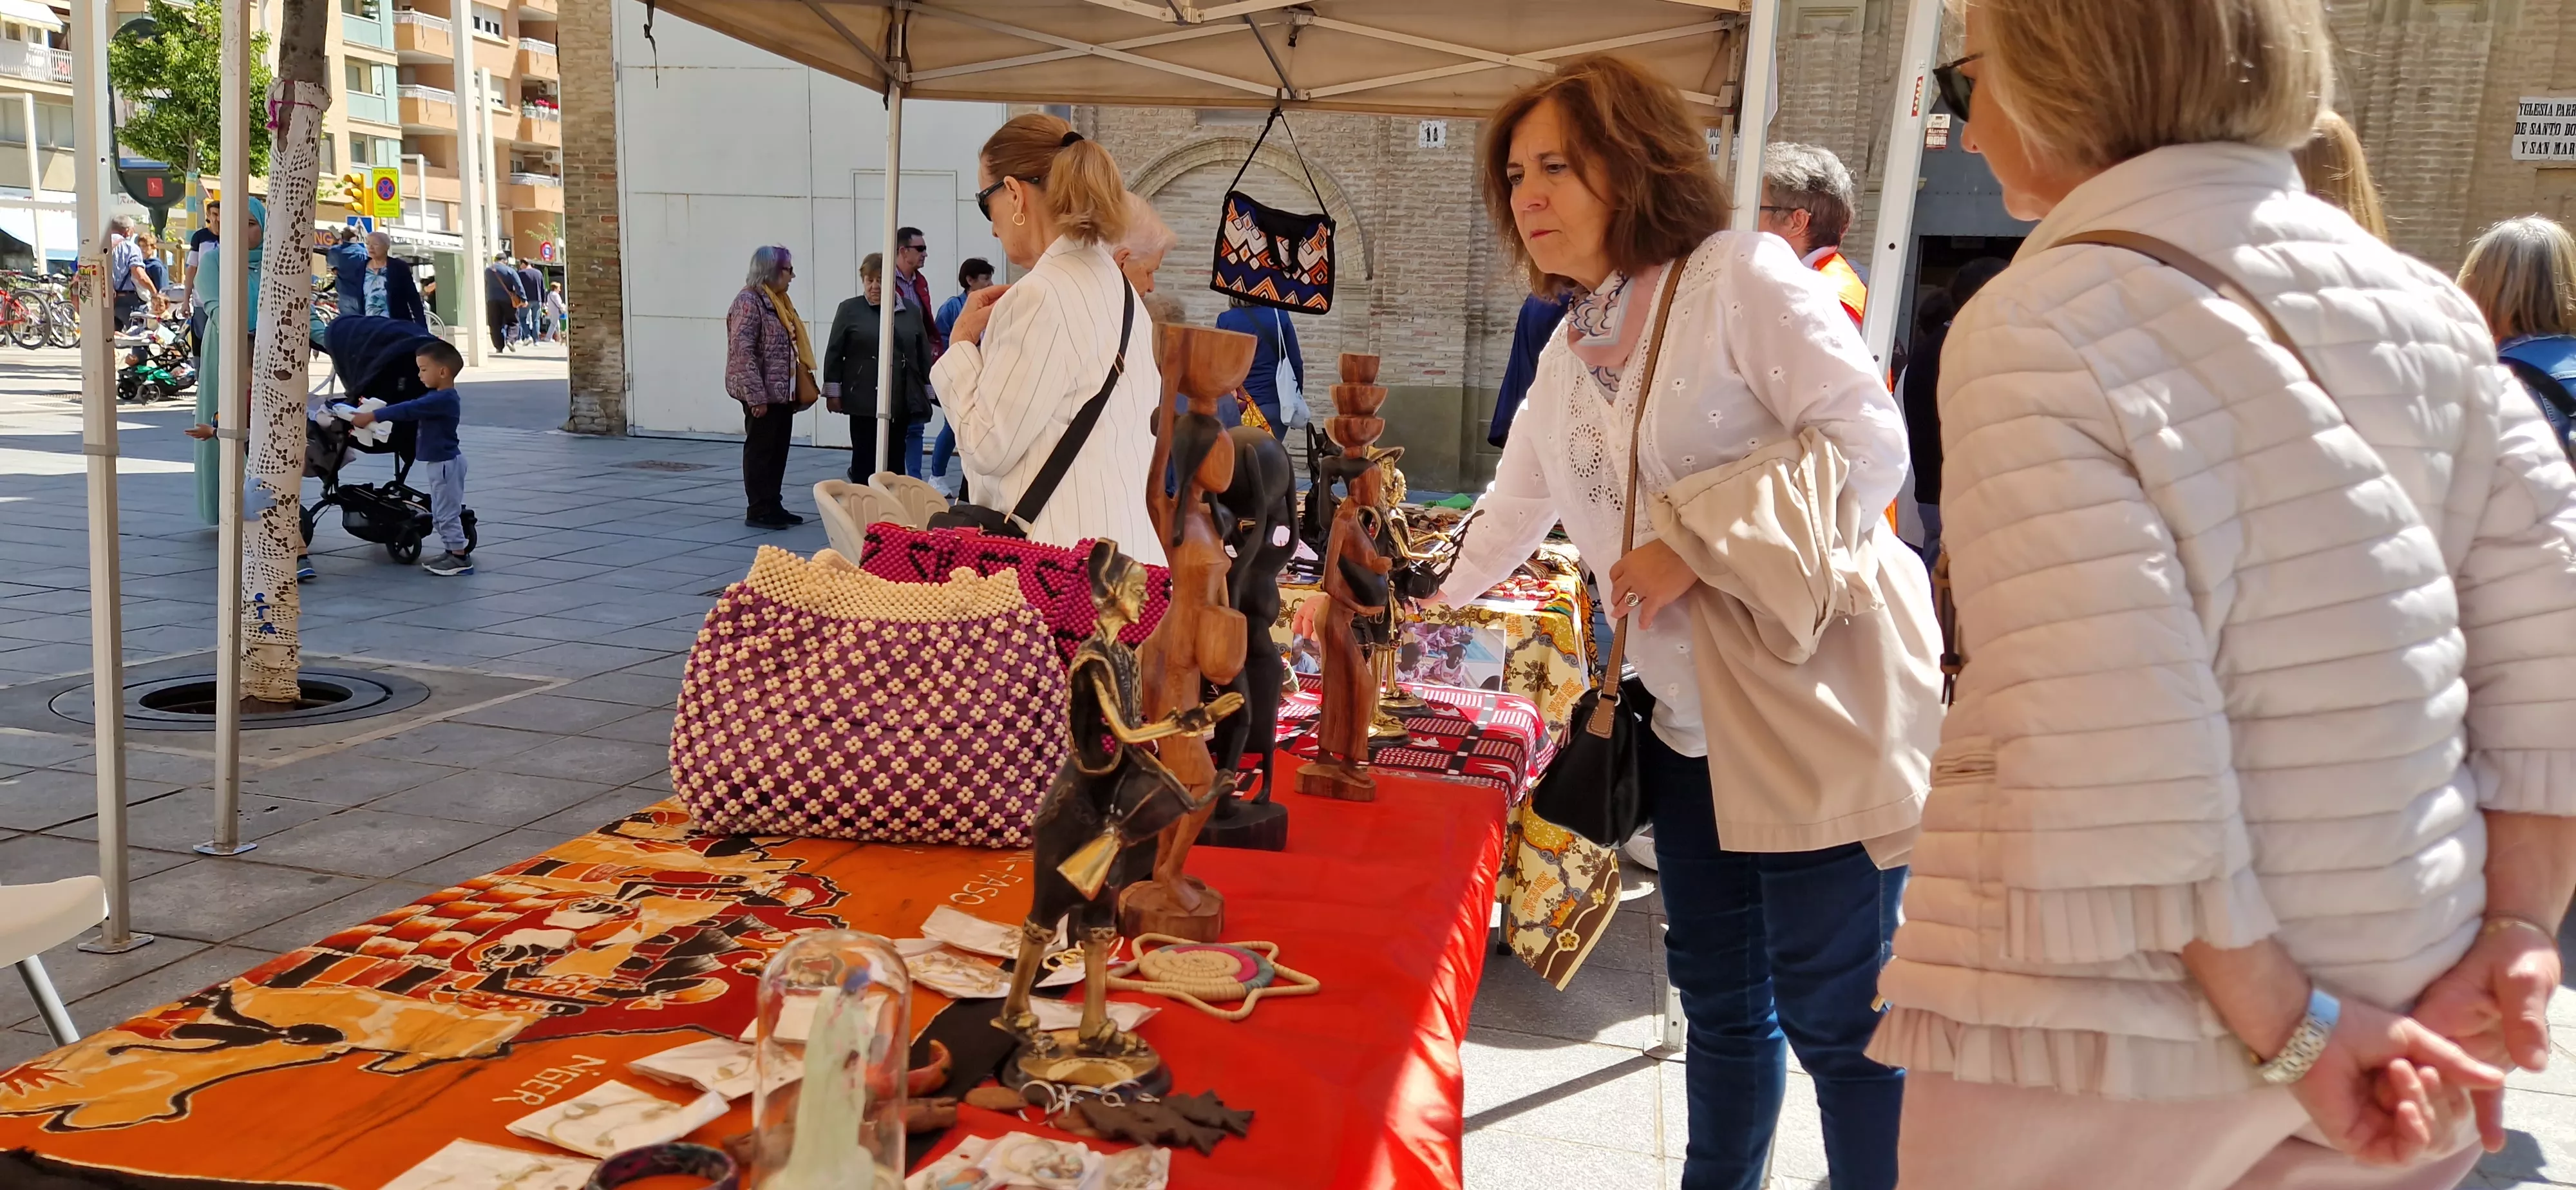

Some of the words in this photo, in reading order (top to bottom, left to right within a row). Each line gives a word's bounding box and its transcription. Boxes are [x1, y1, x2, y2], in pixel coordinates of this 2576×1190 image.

[2519, 103, 2553, 116] YGLESIA
[2514, 122, 2527, 135] DE
[2529, 122, 2561, 136] SANTO
[2564, 123, 2576, 137] DO
[2521, 141, 2527, 154] Y
[2529, 142, 2550, 155] SAN
